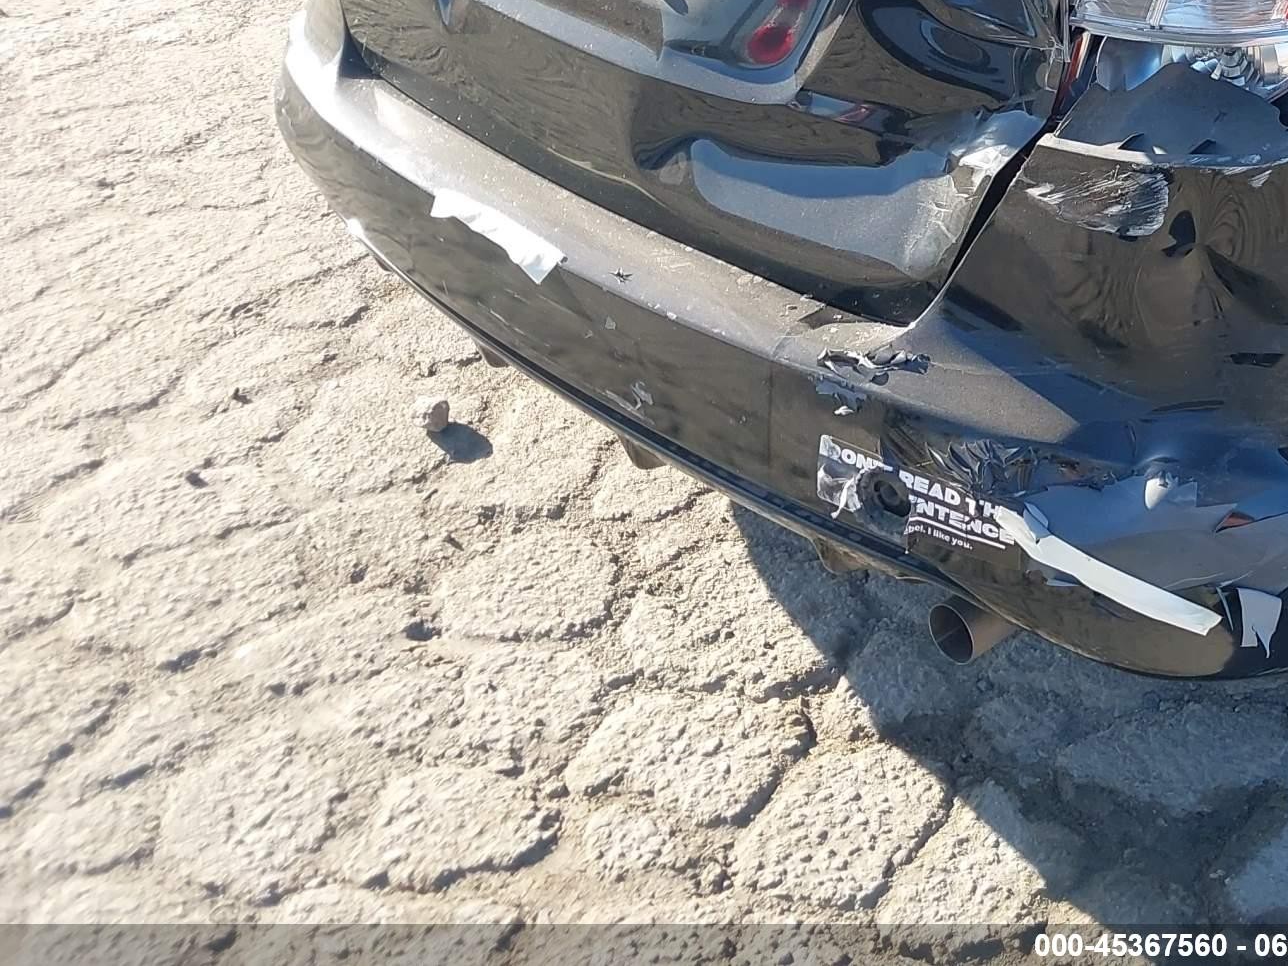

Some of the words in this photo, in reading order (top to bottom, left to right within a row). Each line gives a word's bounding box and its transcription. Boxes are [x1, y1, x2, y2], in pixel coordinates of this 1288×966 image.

[898, 469, 961, 506] READ
[932, 528, 950, 542] like
[950, 535, 973, 550] you.
